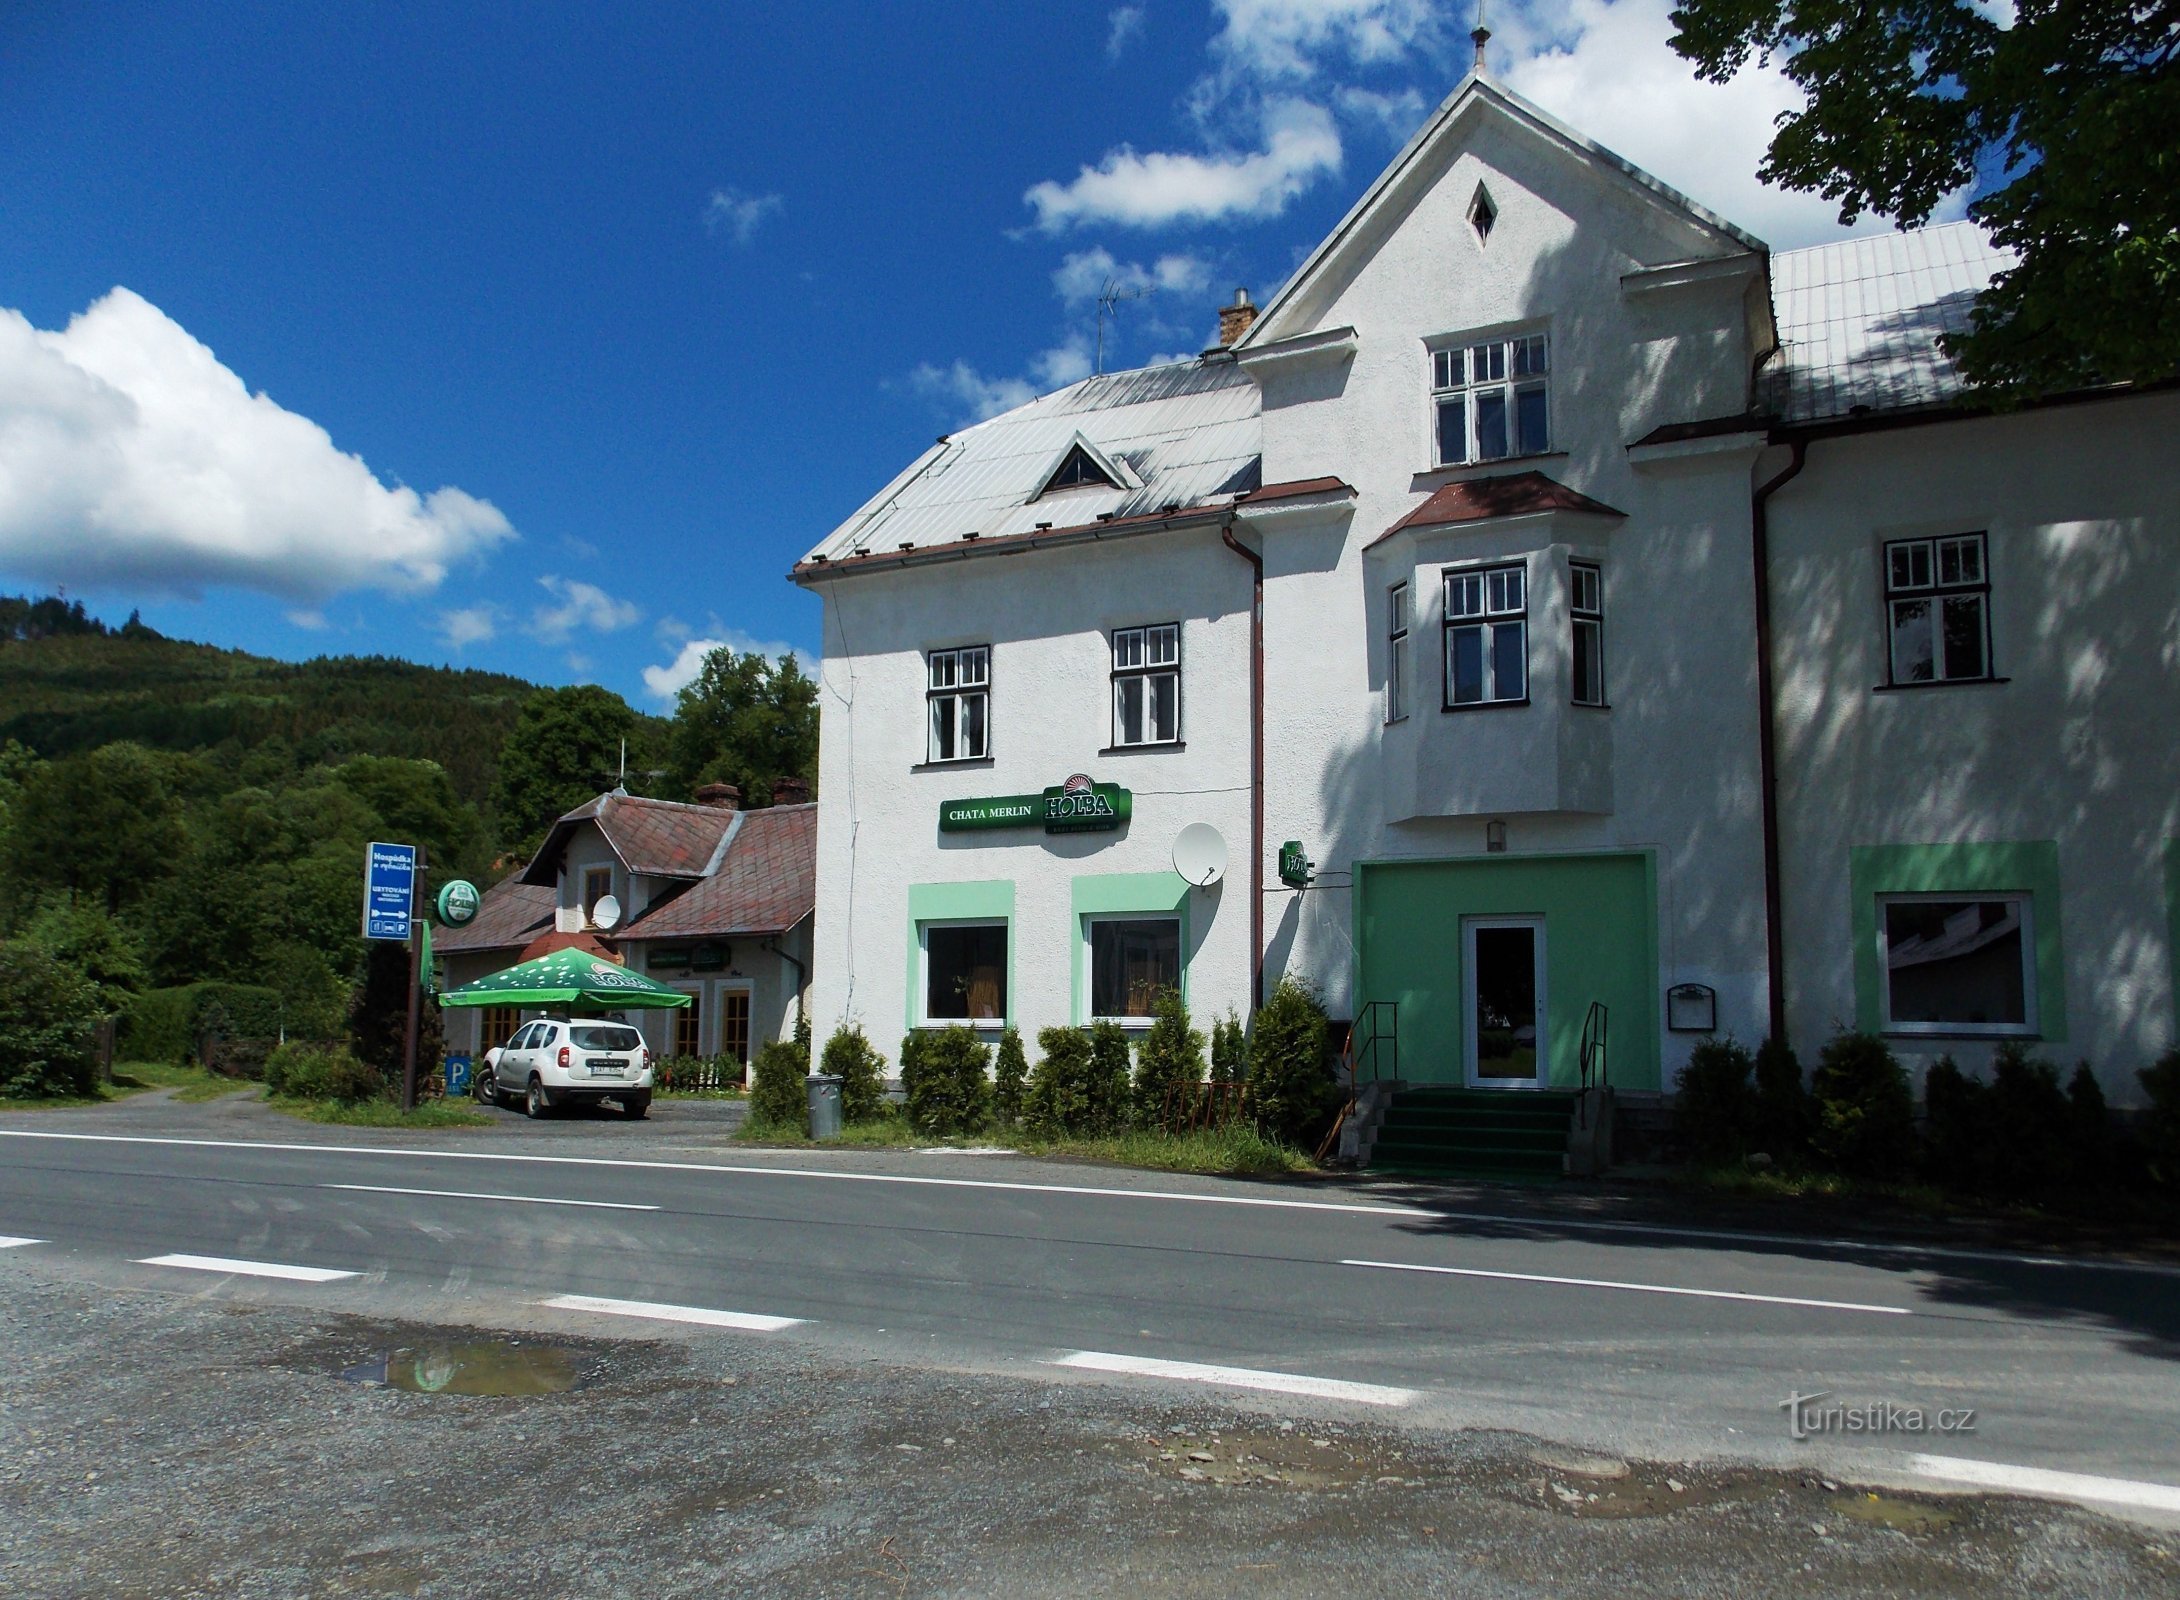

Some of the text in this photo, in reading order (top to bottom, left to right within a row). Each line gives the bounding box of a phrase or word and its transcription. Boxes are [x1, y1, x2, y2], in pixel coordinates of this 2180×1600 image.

[949, 805, 1032, 821] CHATA MERLIN
[1045, 794, 1114, 819] HOLBA
[452, 1062, 465, 1084] P
